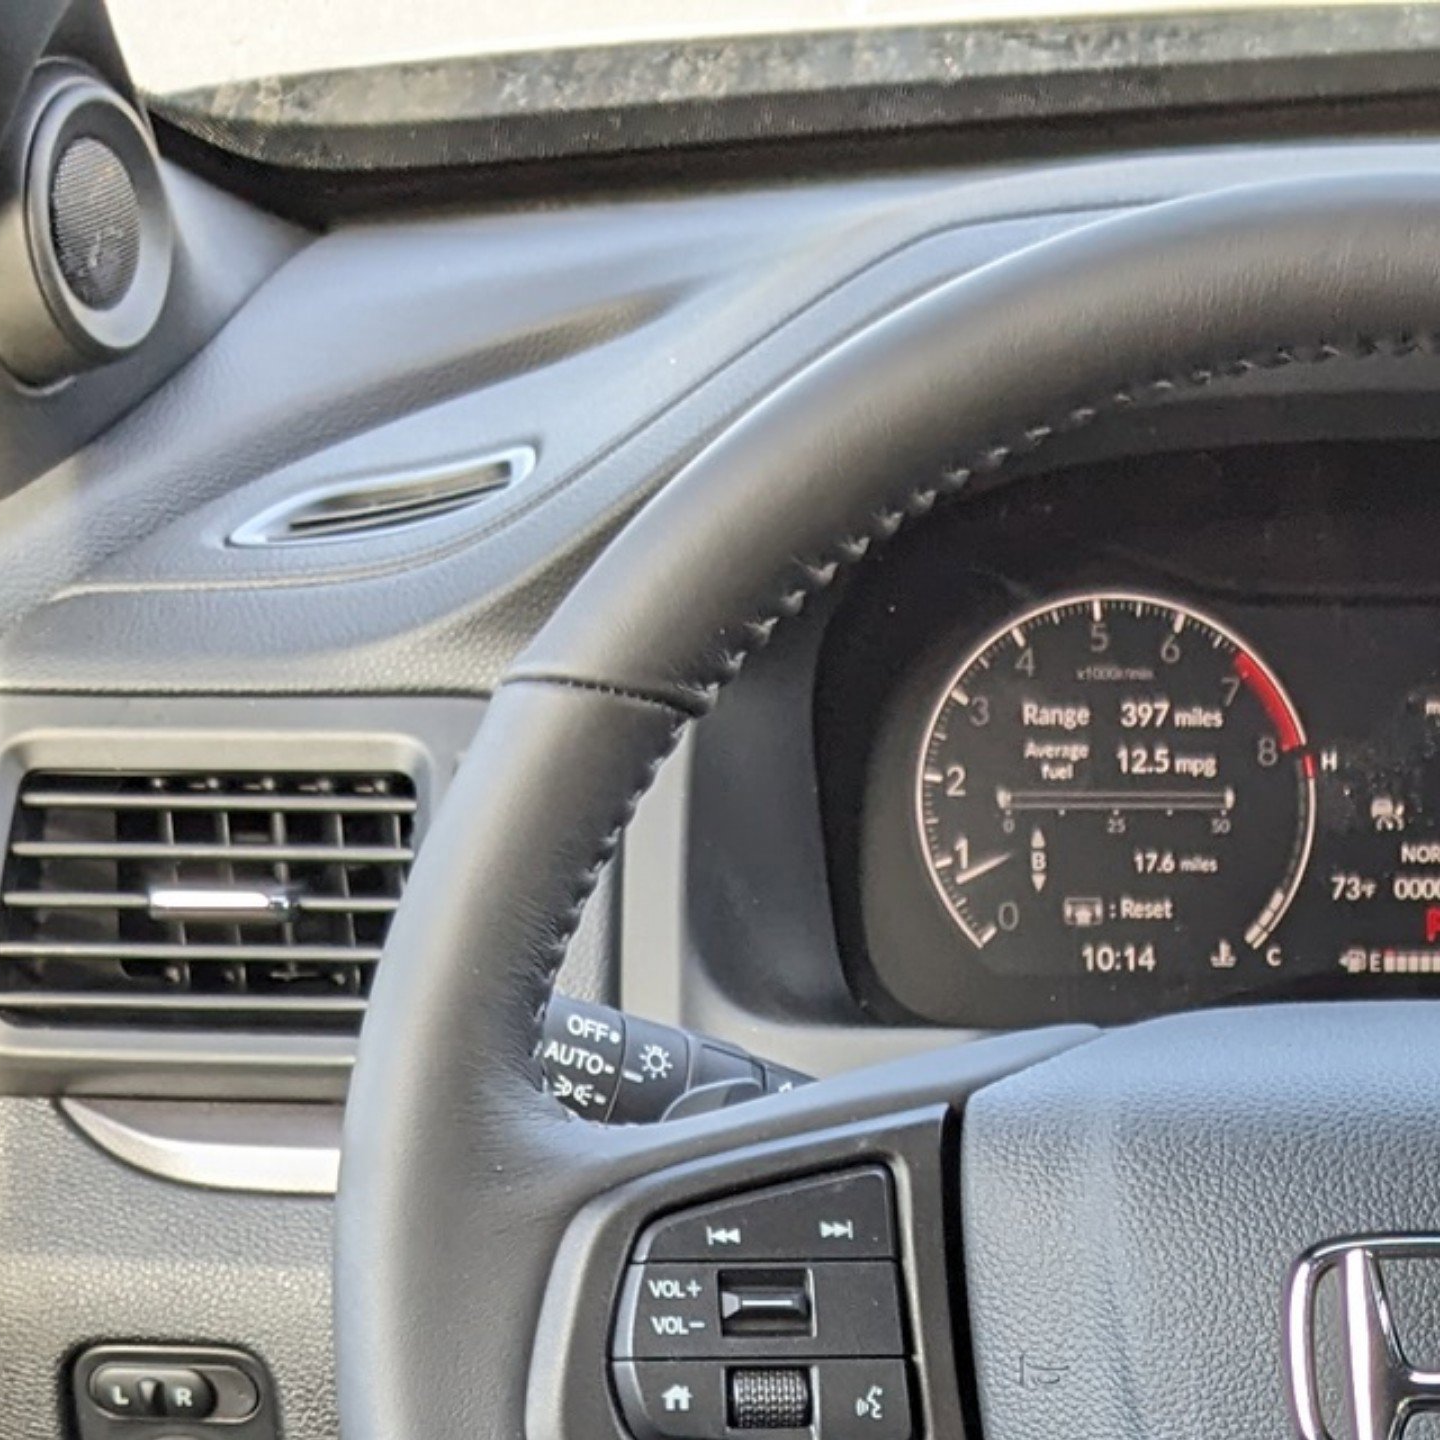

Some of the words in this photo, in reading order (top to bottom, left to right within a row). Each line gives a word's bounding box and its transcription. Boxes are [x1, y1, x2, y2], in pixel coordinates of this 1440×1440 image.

[1091, 624, 1108, 652] 5
[1161, 636, 1180, 664] 6
[1013, 648, 1035, 677] 4
[1221, 677, 1242, 706] 7
[970, 697, 990, 726] 3
[1023, 702, 1090, 732] Range
[1120, 702, 1171, 728] 397
[1174, 704, 1224, 728] miles
[1024, 741, 1090, 763] Average
[1117, 748, 1170, 775] 12.5
[1174, 754, 1218, 778] mpg
[1257, 737, 1277, 767] 8
[1321, 751, 1338, 773] H
[946, 766, 966, 797] 2
[1040, 760, 1074, 781] fuel
[1003, 818, 1014, 834] 0
[1107, 817, 1126, 834] 25
[954, 837, 970, 868] 1
[1031, 851, 1047, 872] B
[1133, 851, 1174, 875] 17.6
[1179, 854, 1218, 874] miles
[997, 903, 1019, 932] 0
[1120, 898, 1173, 921] Reset
[1081, 945, 1157, 973] 10:14
[1265, 946, 1282, 967] C
[1369, 952, 1382, 973] E
[566, 1013, 610, 1044] OFF
[543, 1040, 605, 1075] AUTO
[112, 1385, 130, 1406] L
[175, 1387, 194, 1408] R
